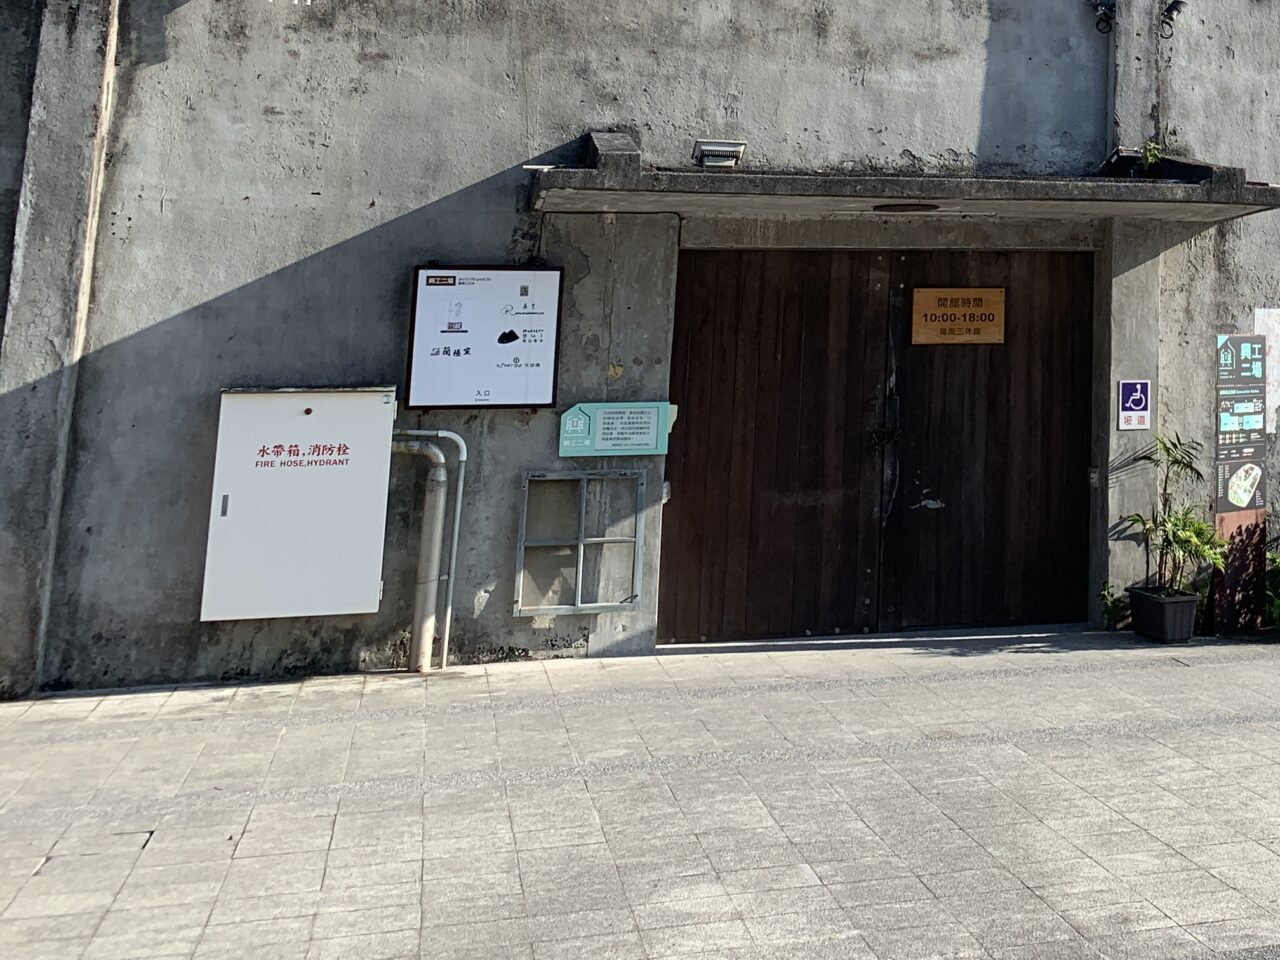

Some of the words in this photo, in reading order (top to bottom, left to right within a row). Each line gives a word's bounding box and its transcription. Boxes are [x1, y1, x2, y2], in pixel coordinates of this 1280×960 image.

[937, 297, 983, 308] 開館時間
[922, 313, 995, 323] 10:00-18:00
[1123, 416, 1146, 425] 坡道
